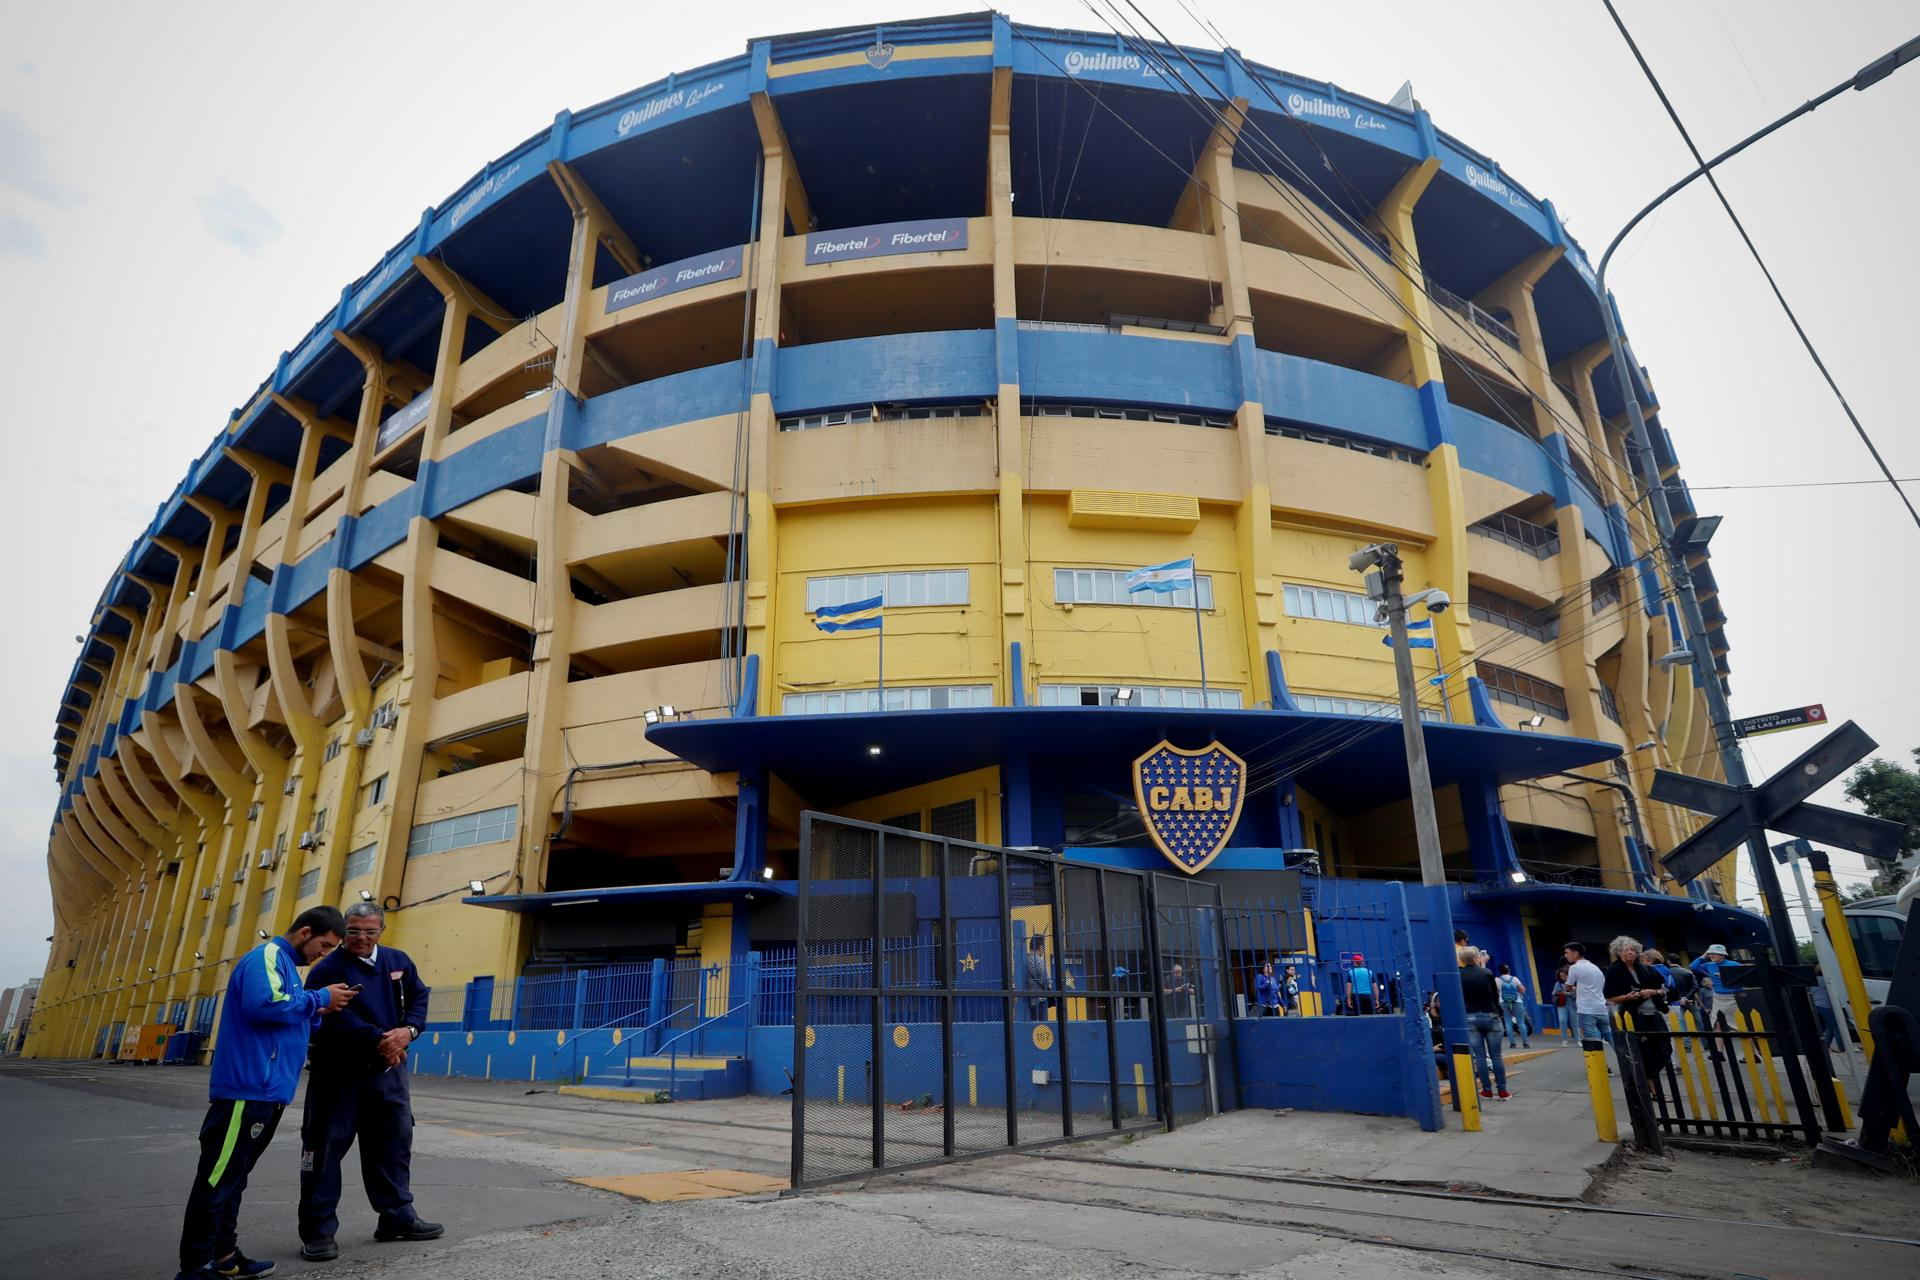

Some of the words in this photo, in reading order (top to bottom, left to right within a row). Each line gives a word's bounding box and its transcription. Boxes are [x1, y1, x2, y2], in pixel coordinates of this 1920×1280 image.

[1064, 50, 1140, 75] Quilmes
[618, 90, 684, 138] Quilmes
[1288, 92, 1351, 120] Quilmes
[1465, 164, 1508, 197] Quilmes
[450, 176, 495, 232] Quilmes
[813, 237, 869, 254] Fibertel
[891, 229, 947, 245] Fibertel
[612, 279, 657, 303] Fibertel
[675, 261, 725, 284] Fibertel
[1743, 715, 1780, 726] DISTRITO
[1775, 716, 1803, 726] ARTES
[1149, 785, 1232, 812] CABJ
